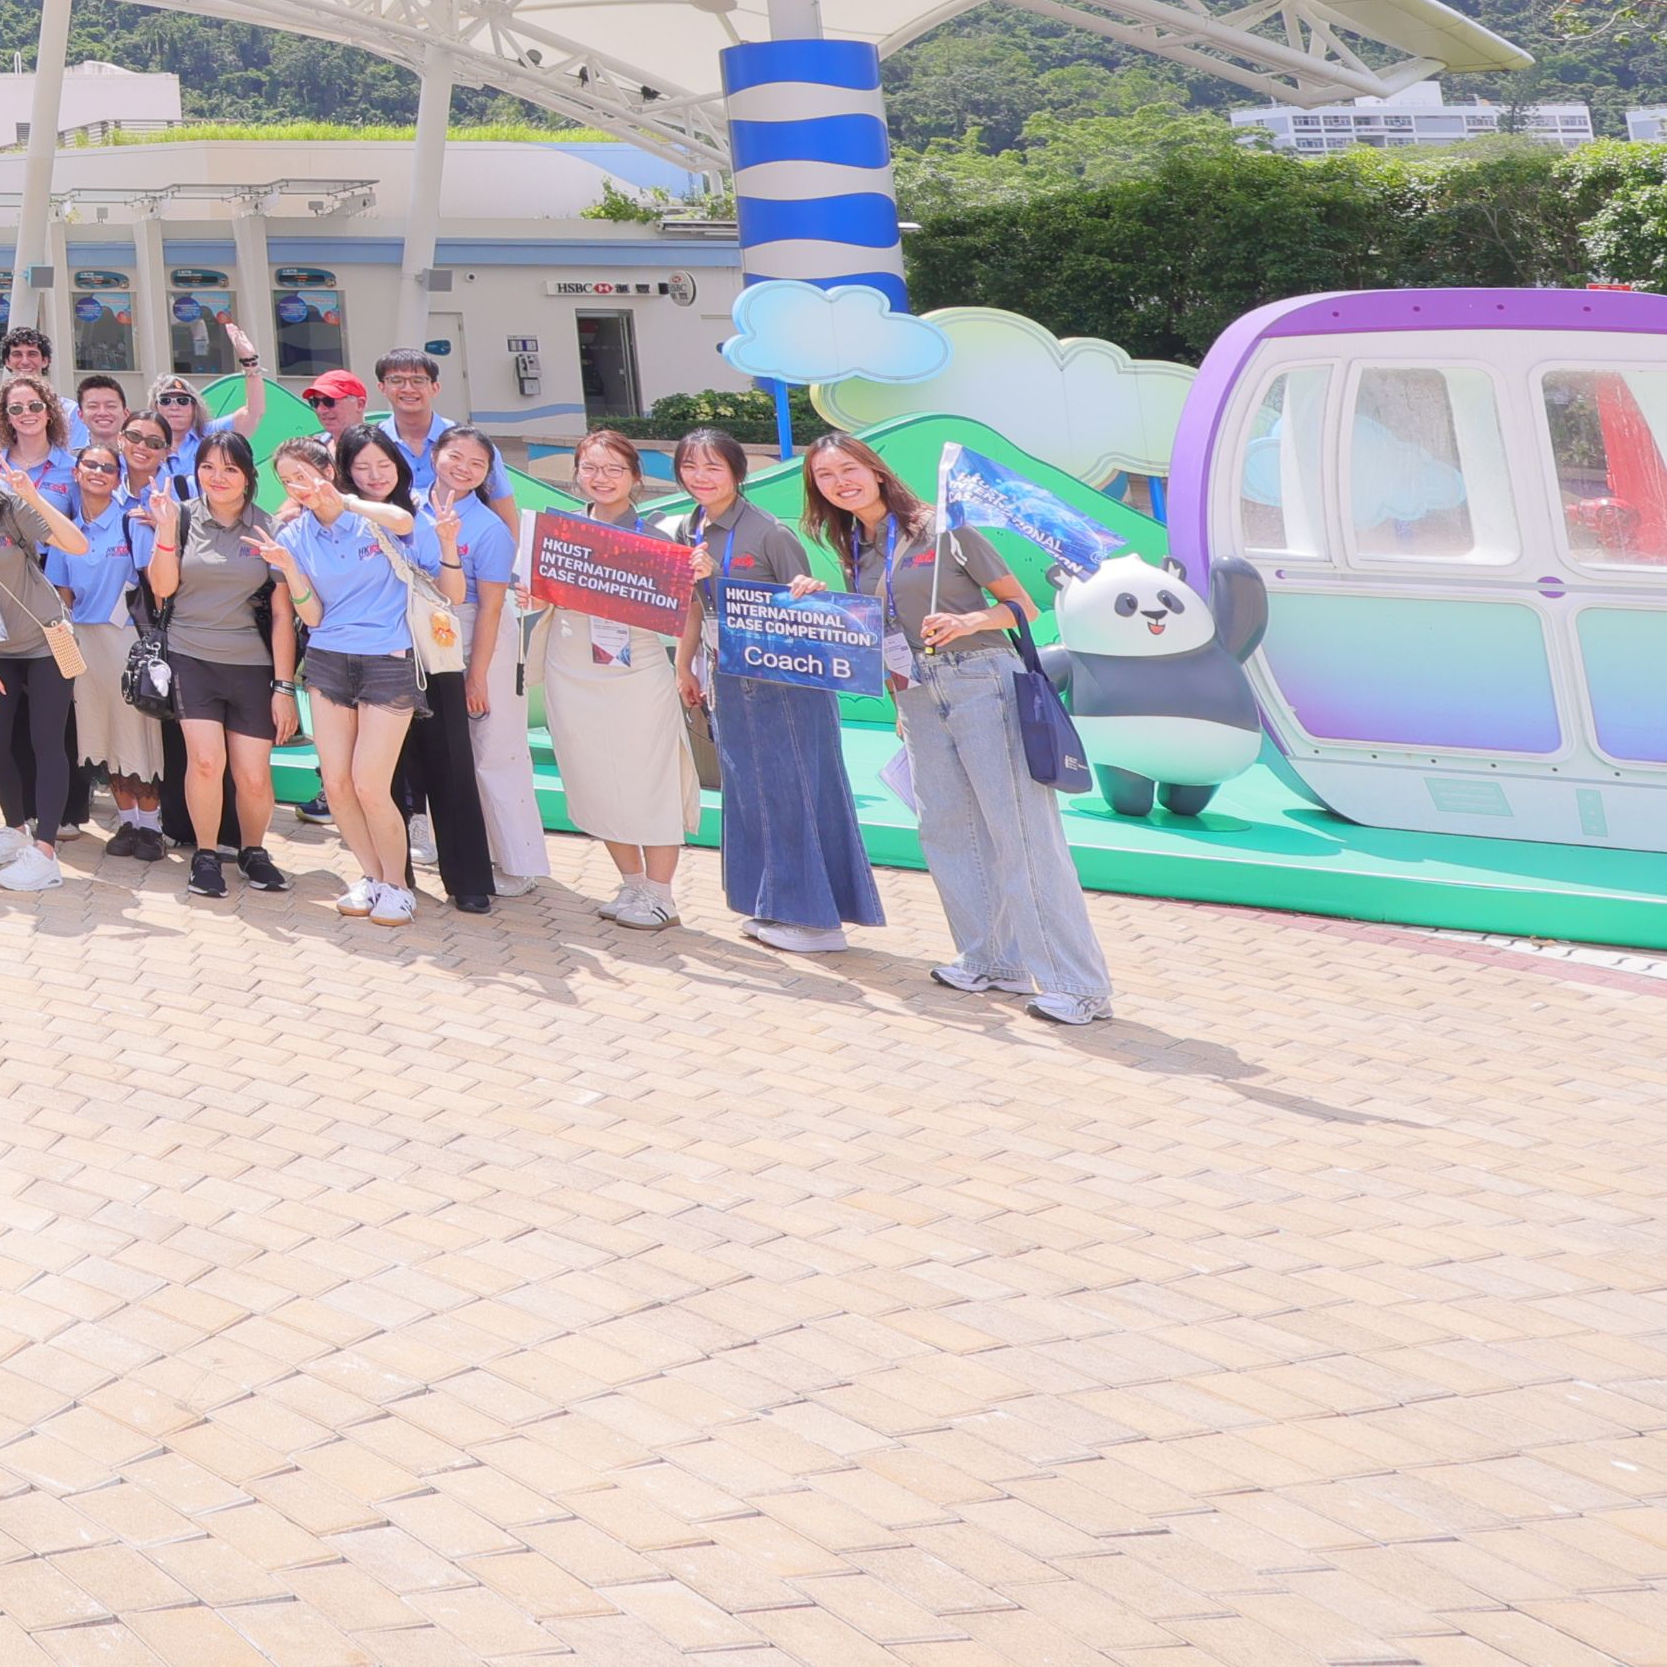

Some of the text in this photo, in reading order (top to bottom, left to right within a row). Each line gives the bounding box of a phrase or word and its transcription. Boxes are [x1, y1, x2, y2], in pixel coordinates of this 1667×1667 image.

[557, 283, 592, 294] HSBC
[542, 537, 592, 560] HKUST
[540, 551, 657, 591] INTERNATIONAL
[538, 565, 679, 611] CASE COMPETITION
[725, 587, 773, 605] HKUST
[726, 601, 846, 629] INTERNATIONAL
[726, 615, 872, 647] CASE COMPETITION
[743, 645, 852, 678] Coach B
